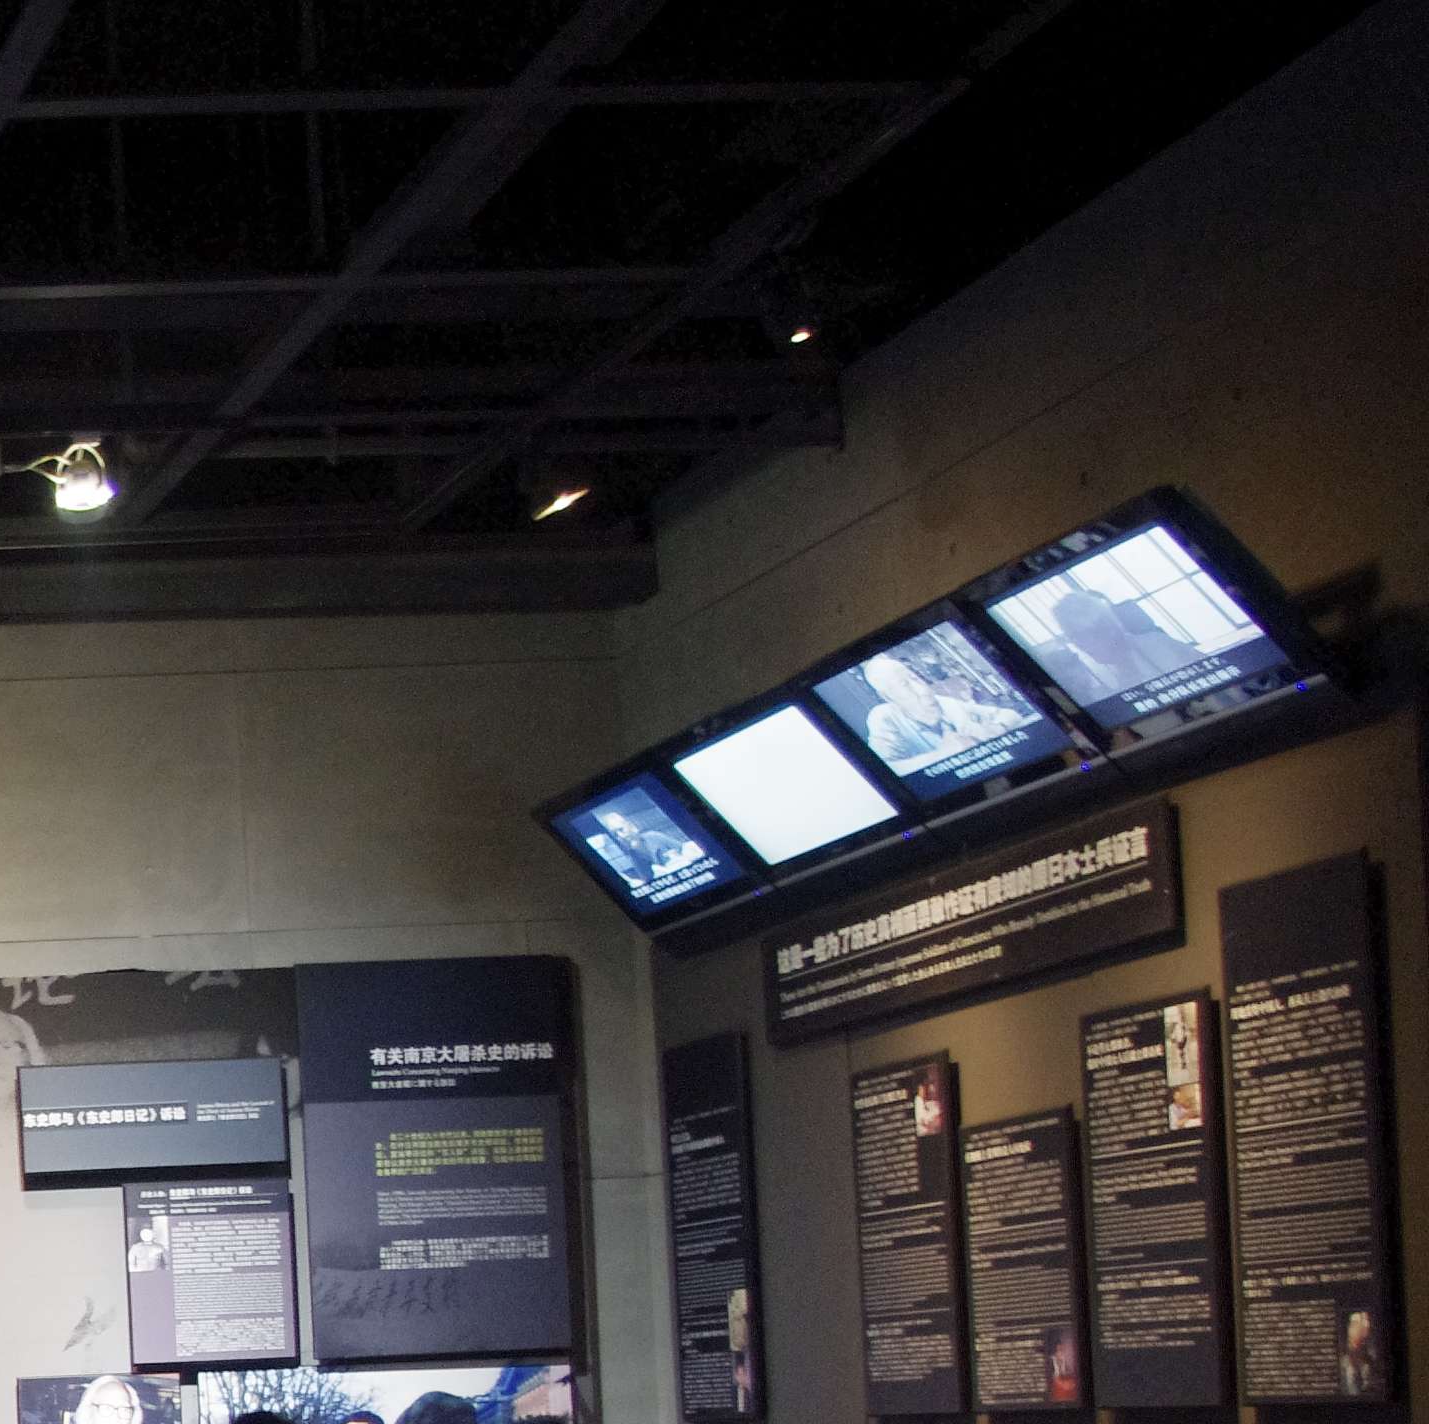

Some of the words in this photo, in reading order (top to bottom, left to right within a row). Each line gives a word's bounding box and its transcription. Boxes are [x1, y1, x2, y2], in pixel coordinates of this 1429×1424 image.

[369, 1042, 553, 1065] 有关南京大屠杀史的诉讼
